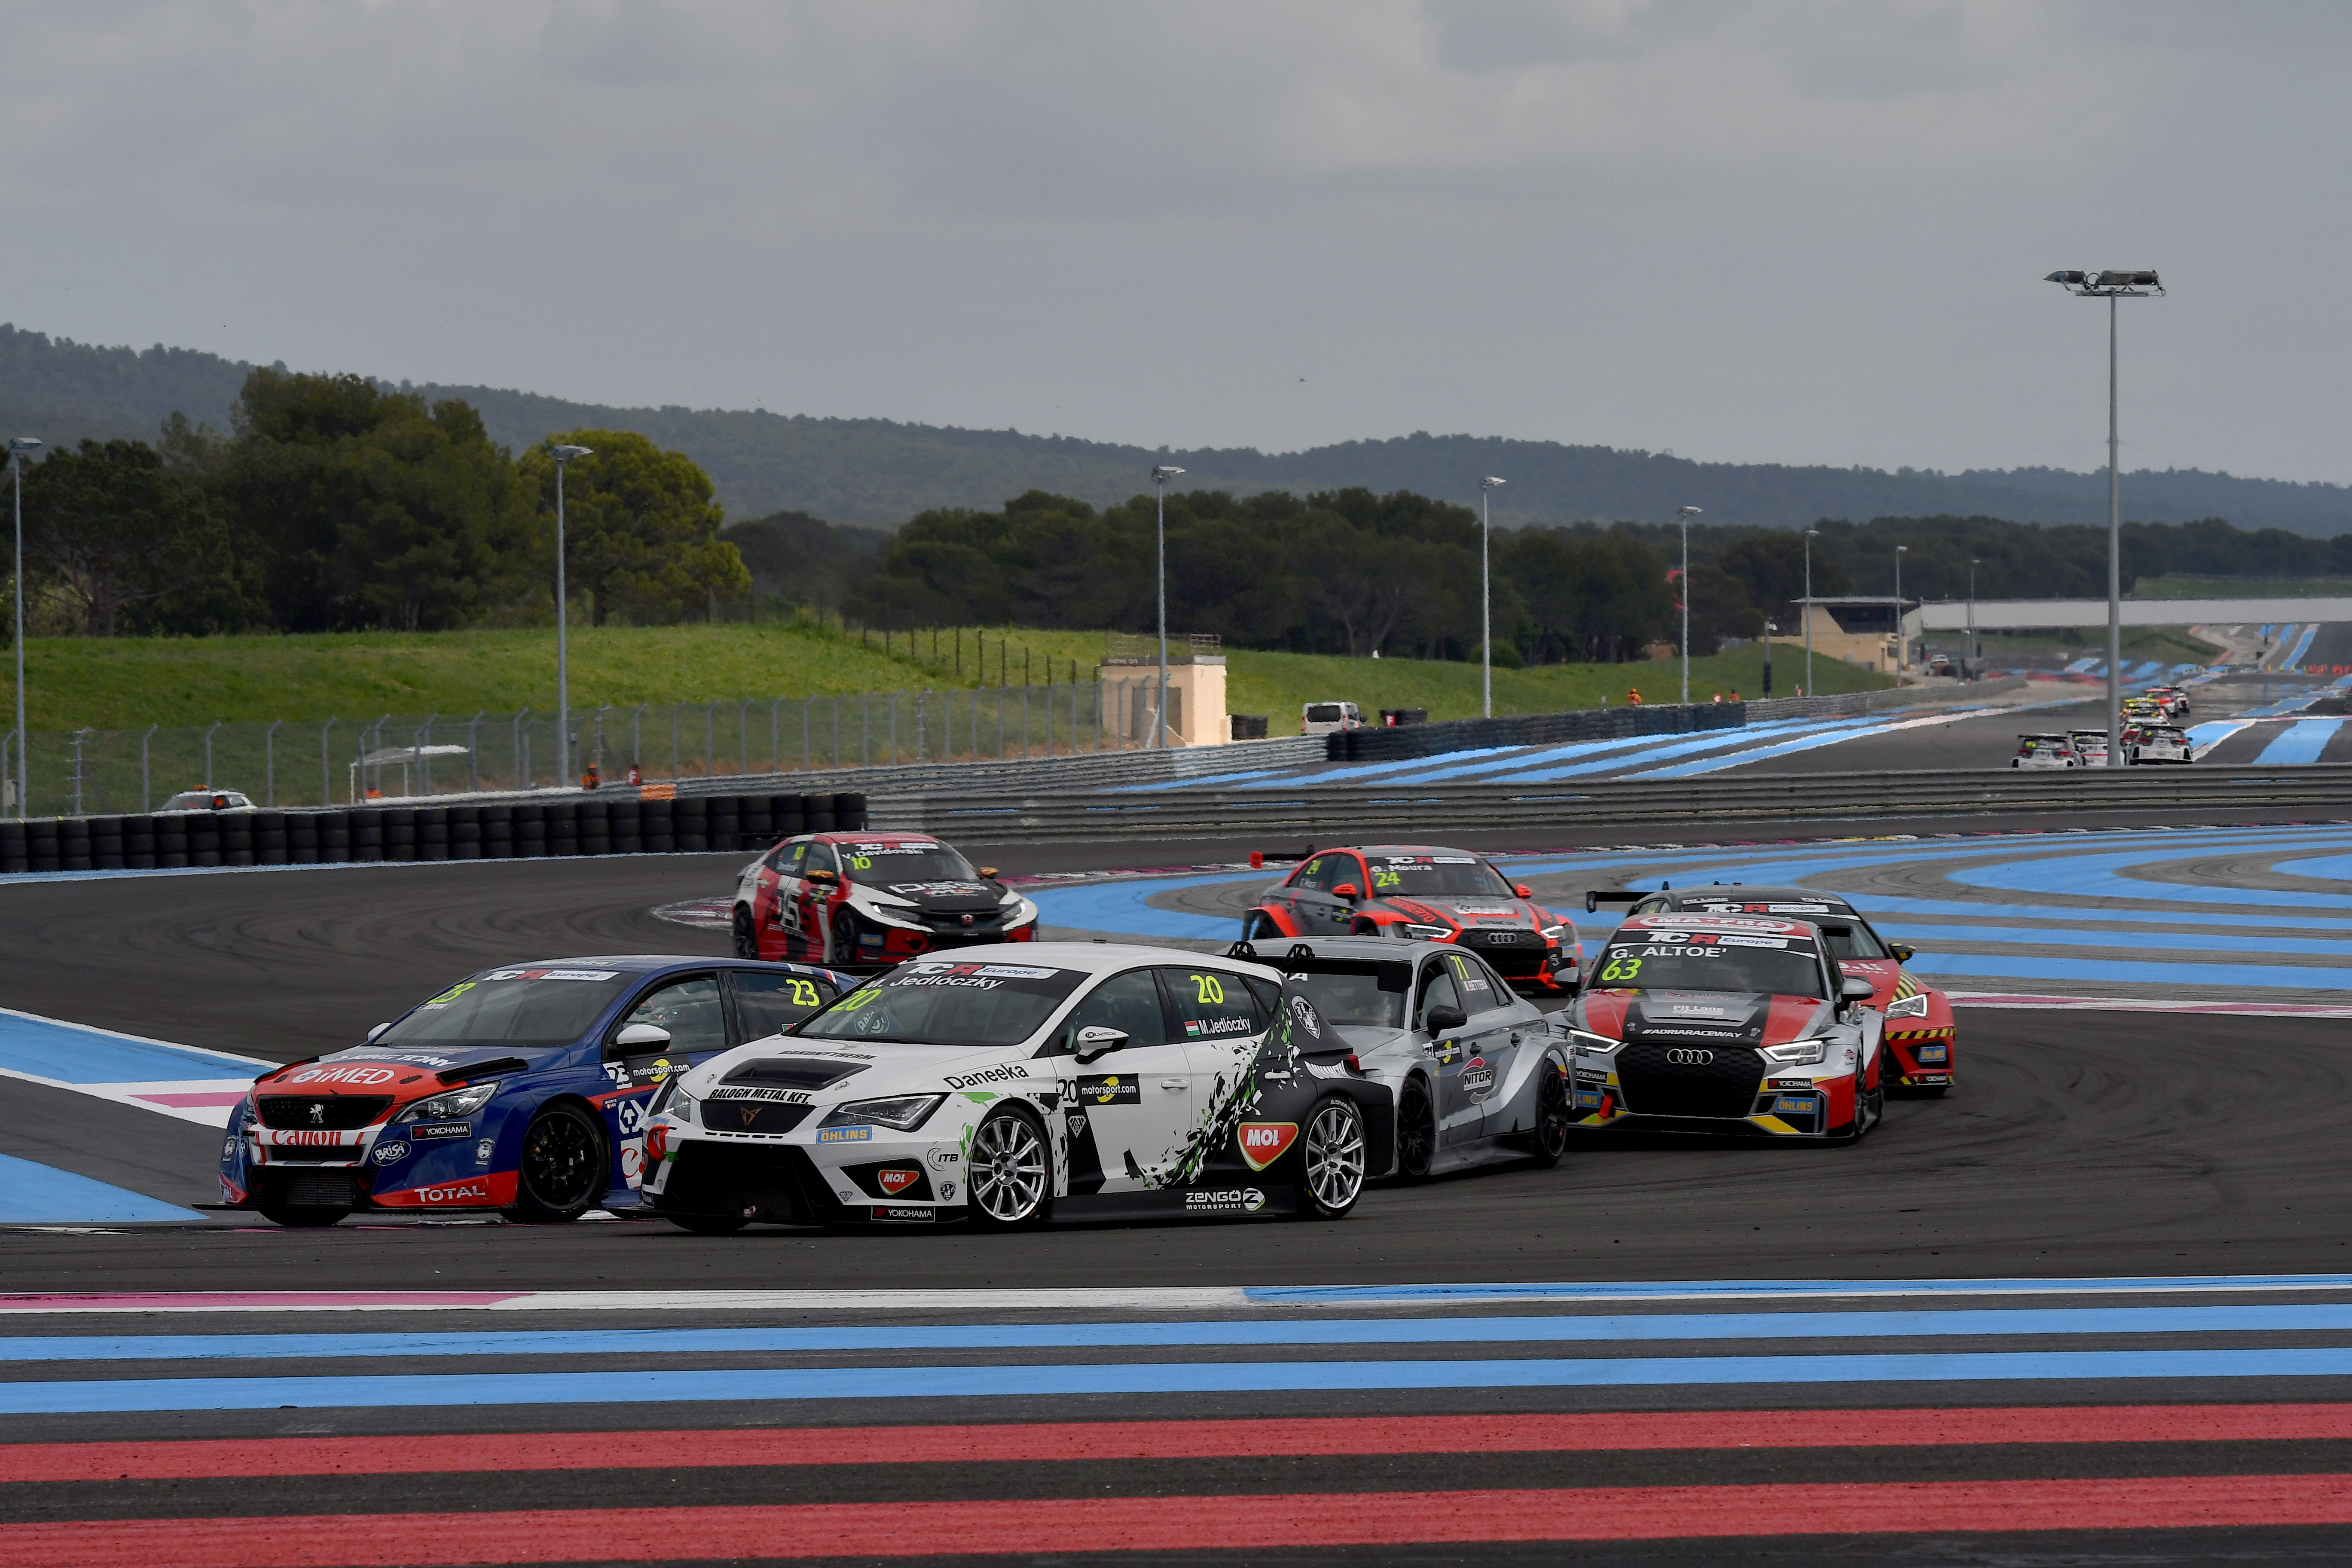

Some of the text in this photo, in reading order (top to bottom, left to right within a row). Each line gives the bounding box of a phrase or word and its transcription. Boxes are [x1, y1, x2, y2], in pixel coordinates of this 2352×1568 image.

[851, 856, 872, 870] 10
[1375, 872, 1401, 887] 24
[1702, 904, 1769, 913] TCR
[1647, 931, 1719, 944] TCR
[1610, 946, 1727, 959] G. ALTOE'
[905, 963, 1038, 975] TCR Europe
[1449, 956, 1469, 979] 71
[1601, 958, 1643, 981] 63
[482, 970, 551, 981] TCR
[861, 975, 1005, 991] M. Jedlóczky
[1190, 975, 1224, 1004] 20
[785, 979, 820, 1007] 23
[827, 988, 882, 1012] 20
[1641, 1029, 1744, 1038] #ADRIARACEWAY
[397, 1055, 458, 1067] TONY
[606, 1064, 630, 1085] 23
[632, 1064, 690, 1077] motorsport.com
[944, 1064, 1030, 1090] Daneeka
[1464, 1070, 1491, 1085] NITOR
[709, 1088, 813, 1104] BALOGH METÁL KFT.
[1057, 1079, 1078, 1103] 20
[1081, 1084, 1136, 1097] motorsport.com
[1330, 1099, 1353, 1115] ADVAN
[272, 1129, 342, 1146] Canon
[426, 1126, 468, 1135] YOKOHAMA
[821, 1129, 867, 1141] ÖHLINS
[1246, 1129, 1280, 1147] MOL
[938, 1153, 959, 1162] ITB
[883, 1173, 906, 1183] MOL
[888, 1209, 932, 1218] YOKOHAMA
